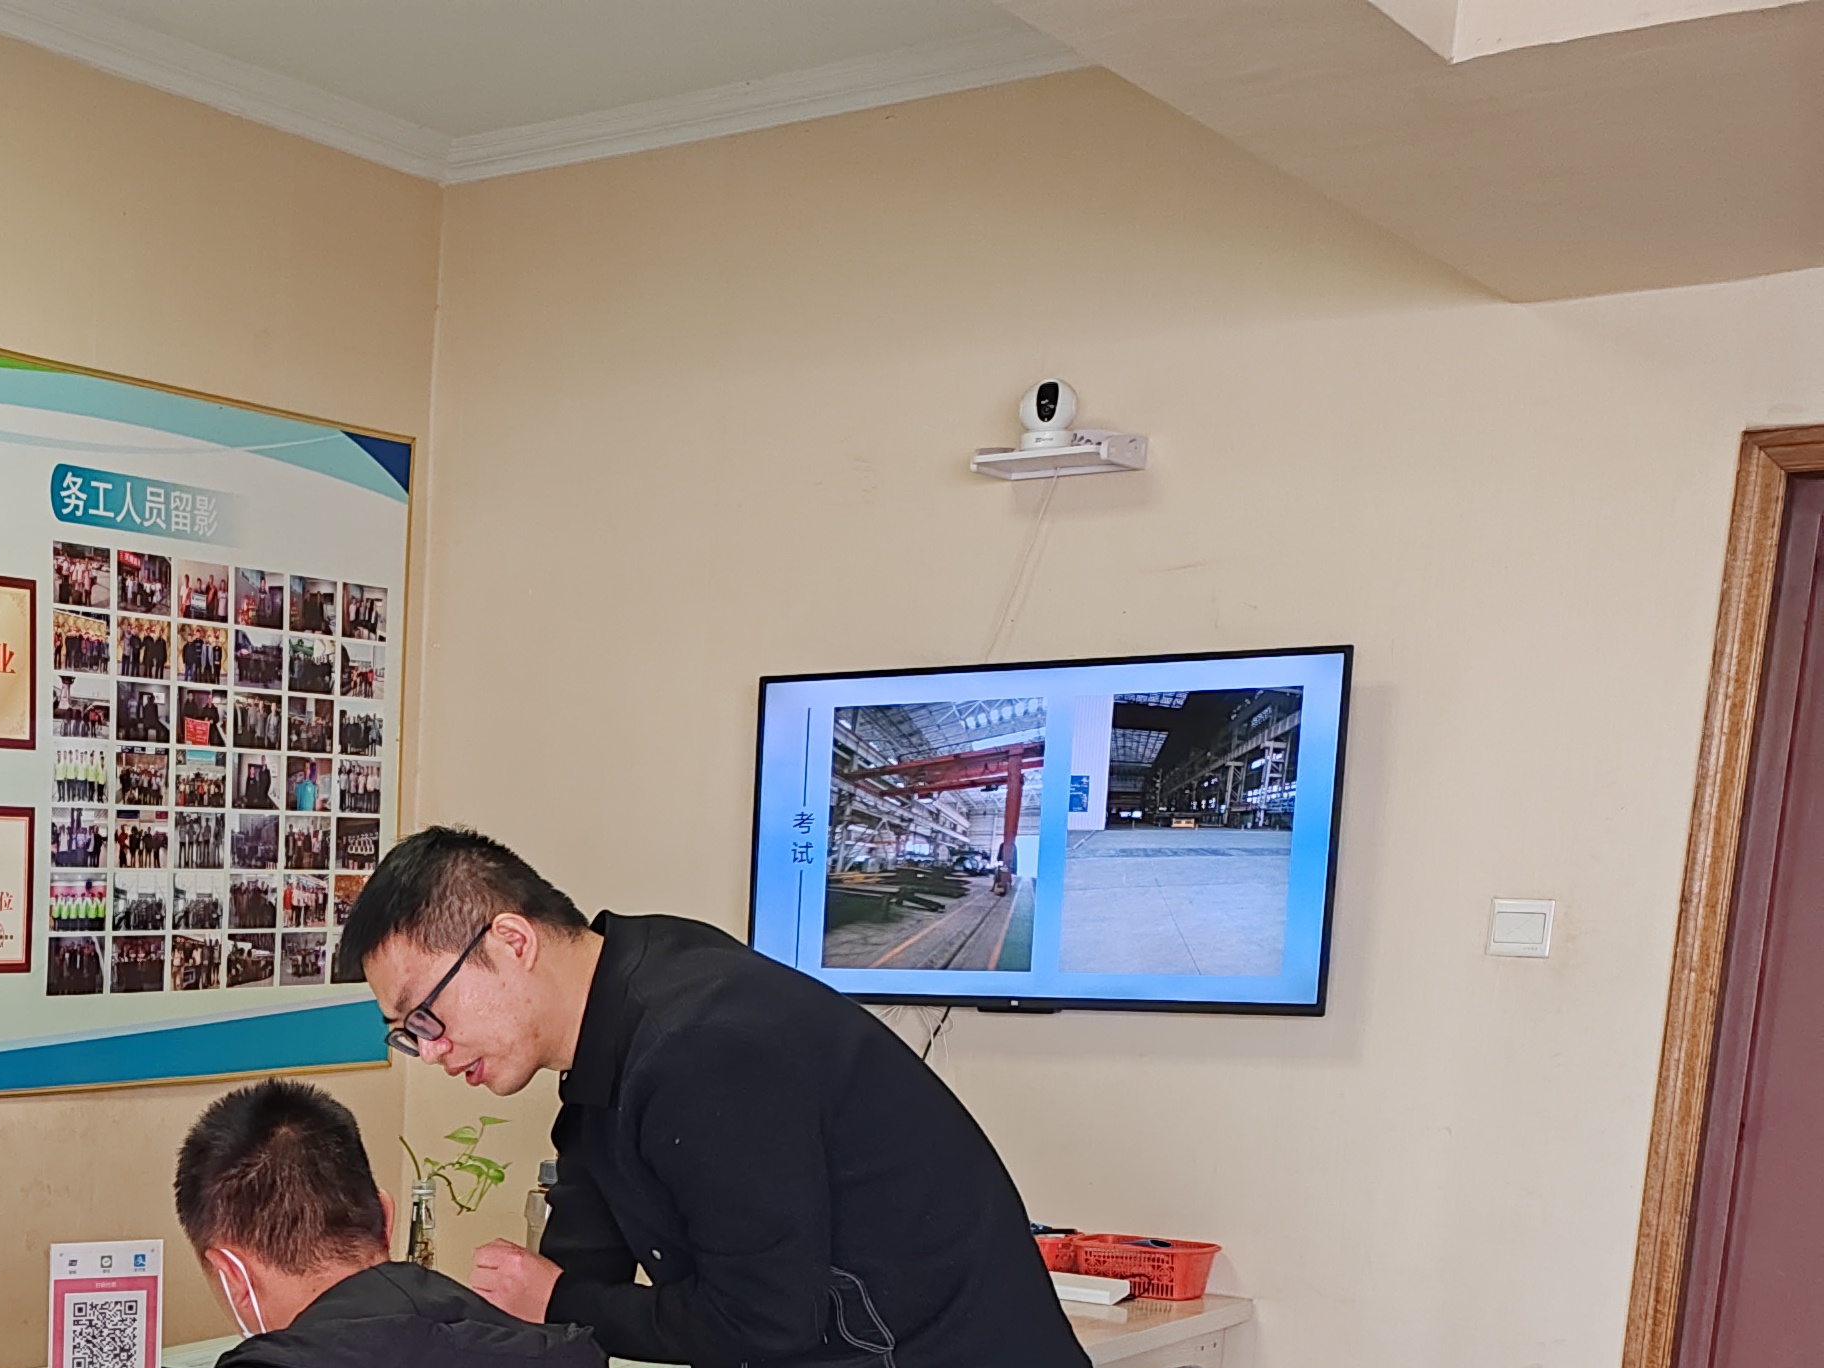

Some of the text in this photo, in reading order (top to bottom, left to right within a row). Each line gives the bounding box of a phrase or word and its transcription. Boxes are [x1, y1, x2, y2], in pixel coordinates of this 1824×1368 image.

[59, 471, 218, 538] 务工人员留影
[792, 811, 815, 865] 考试
